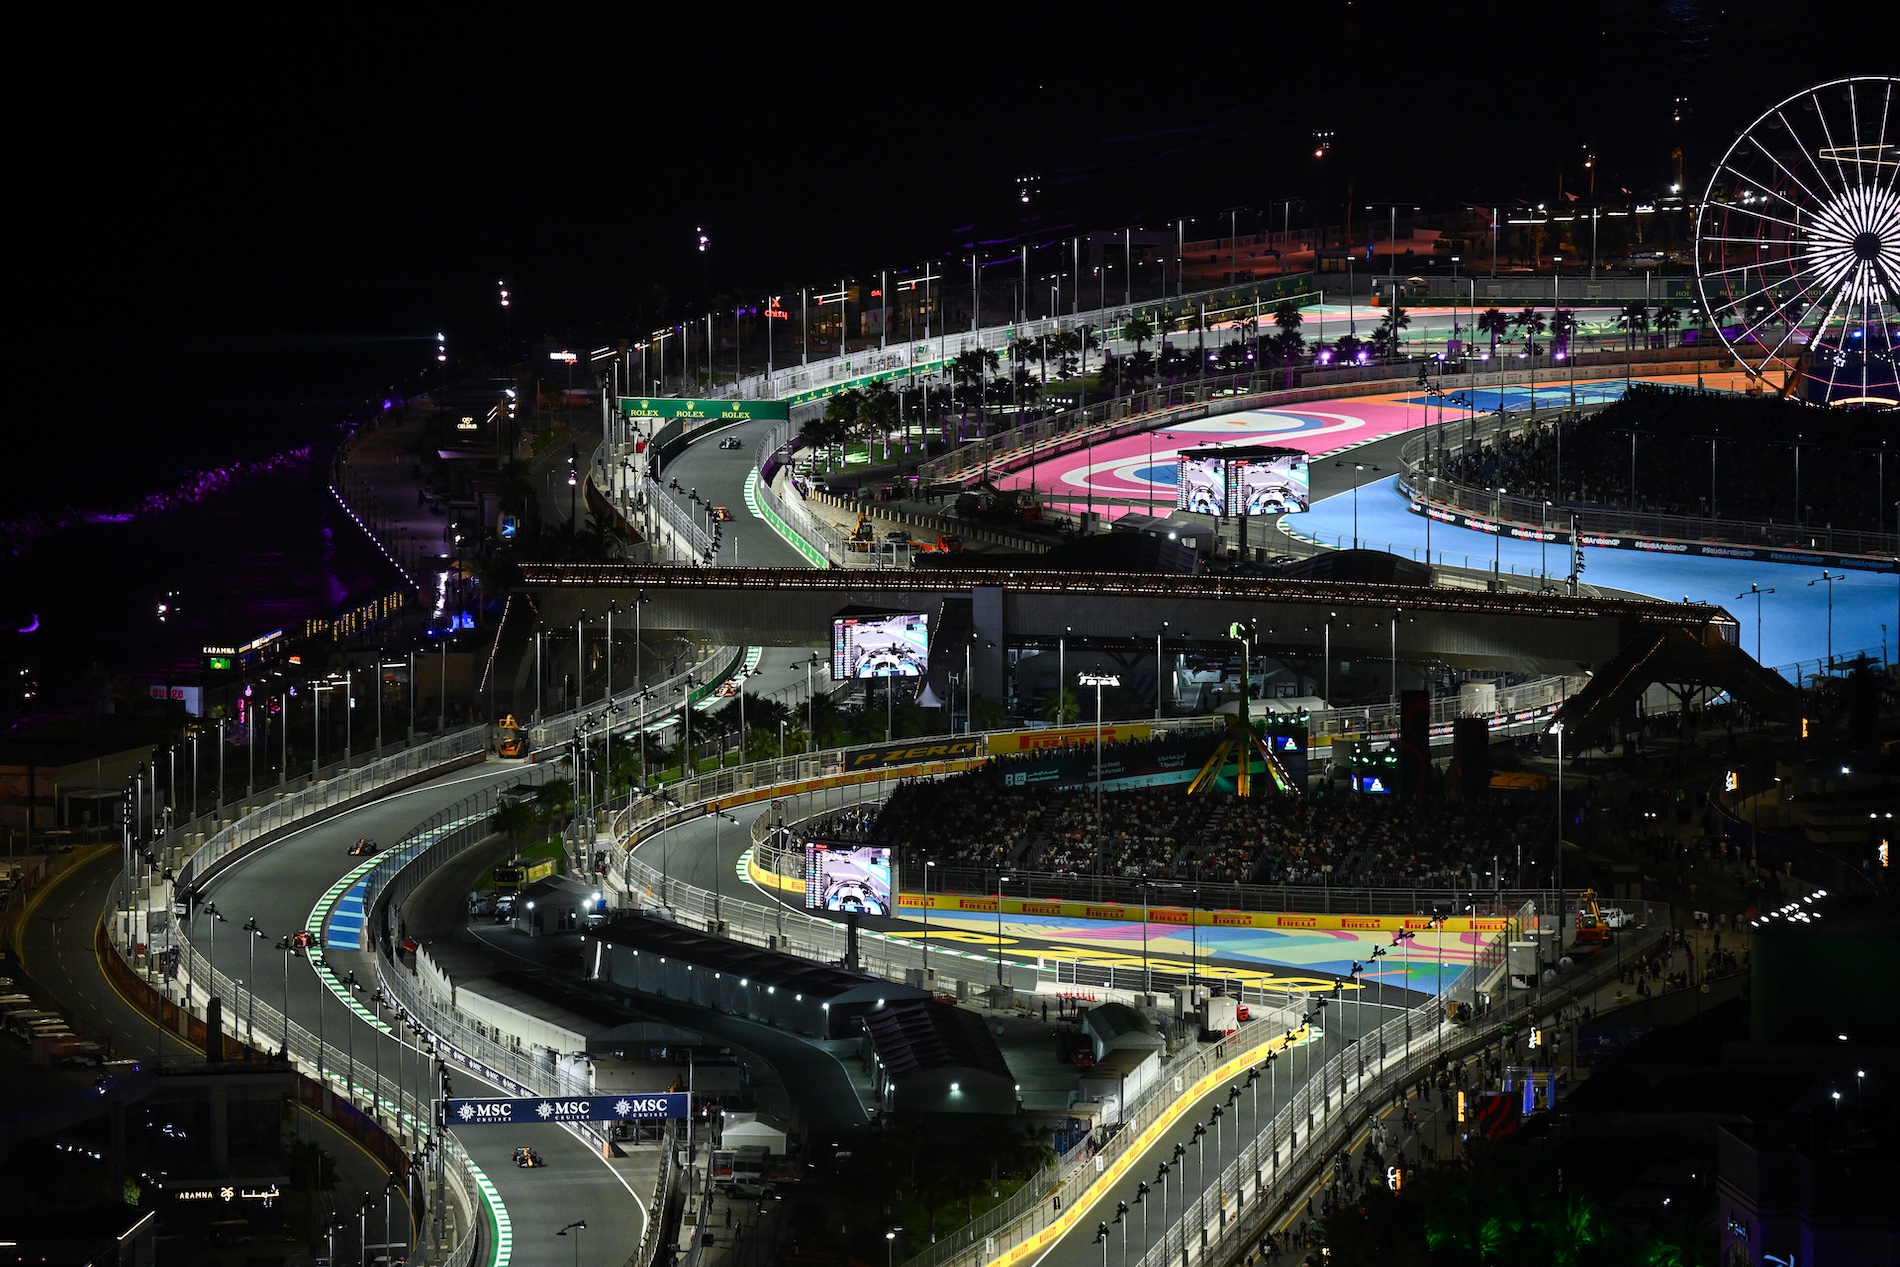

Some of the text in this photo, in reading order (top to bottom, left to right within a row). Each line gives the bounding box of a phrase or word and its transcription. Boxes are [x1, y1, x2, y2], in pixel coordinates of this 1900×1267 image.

[676, 410, 705, 418] ROLEX
[1634, 540, 1688, 552] #SaudiArabianGP
[1702, 546, 1755, 557] #SaudiArabianGP
[1019, 729, 1116, 750] PIREI
[853, 742, 976, 765] P ZERO
[959, 899, 998, 911] PIRELLI
[1022, 903, 1061, 915] PIRELLI
[1086, 906, 1125, 918] PIRELLI
[1150, 910, 1188, 922] PIRELLI
[1213, 914, 1252, 925] PIRELLI
[1277, 917, 1316, 927] PIRELLI
[1341, 918, 1380, 929] PIRELLI
[1404, 920, 1444, 930] PIRE
[477, 1103, 512, 1117] MSC
[555, 1101, 590, 1115] MSC
[632, 1098, 667, 1112] MSC
[1039, 1226, 1056, 1243] PIRELLI
[1011, 1243, 1028, 1260] PIRELLI
